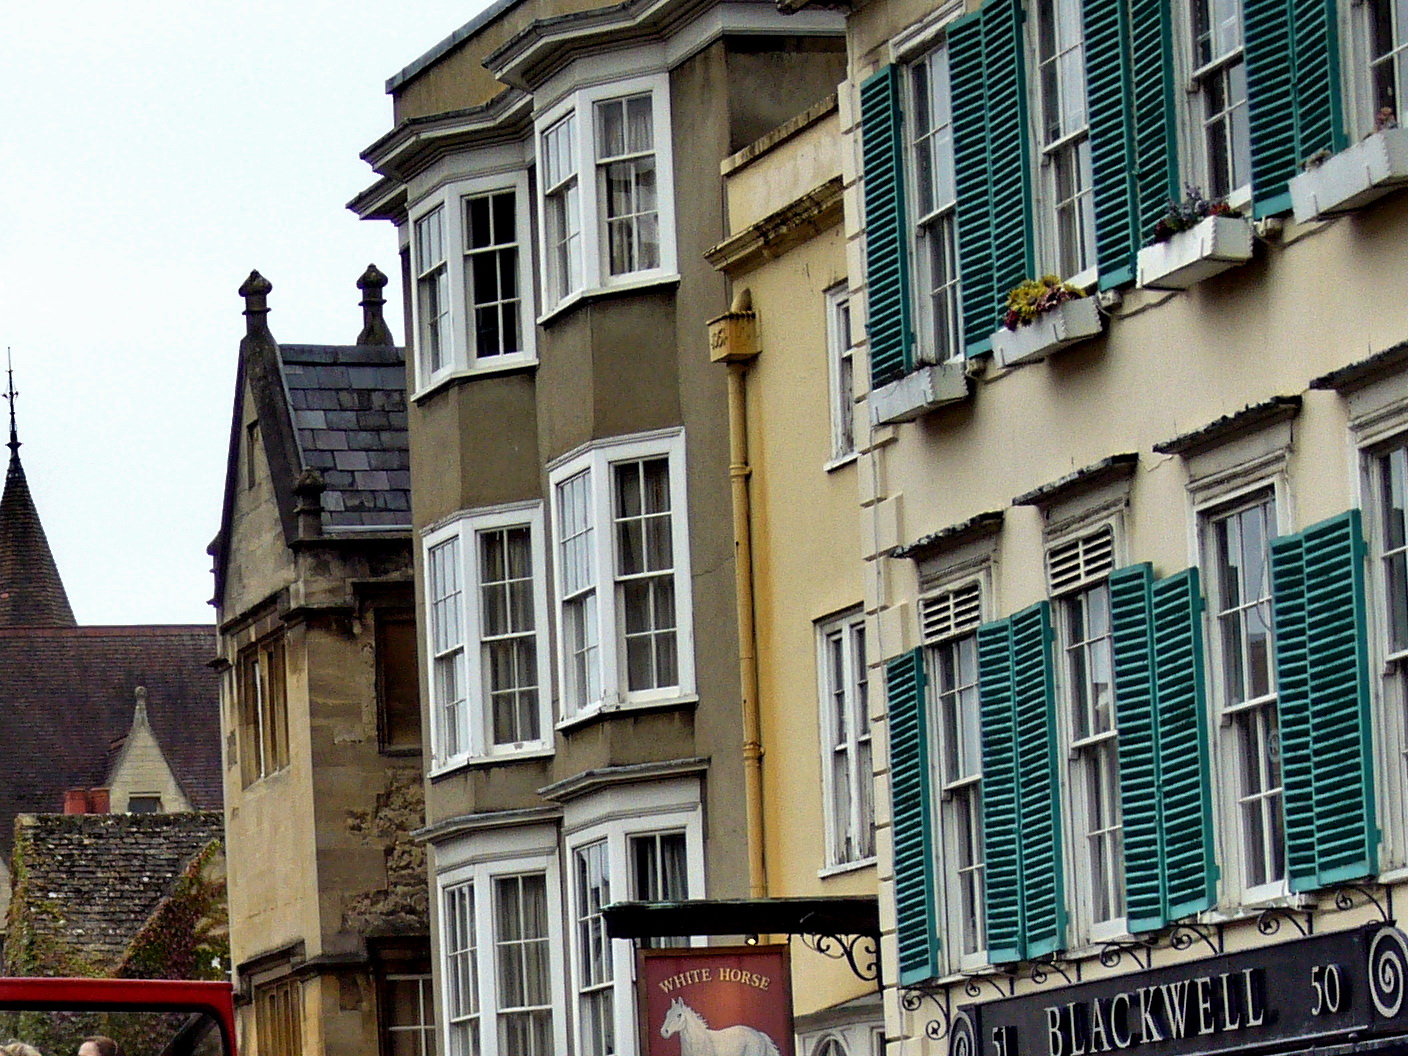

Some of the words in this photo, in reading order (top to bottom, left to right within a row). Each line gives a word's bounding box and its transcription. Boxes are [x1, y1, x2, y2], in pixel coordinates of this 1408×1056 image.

[659, 968, 712, 994] WHITE
[719, 968, 771, 991] HORSE
[1311, 964, 1340, 1017] 50
